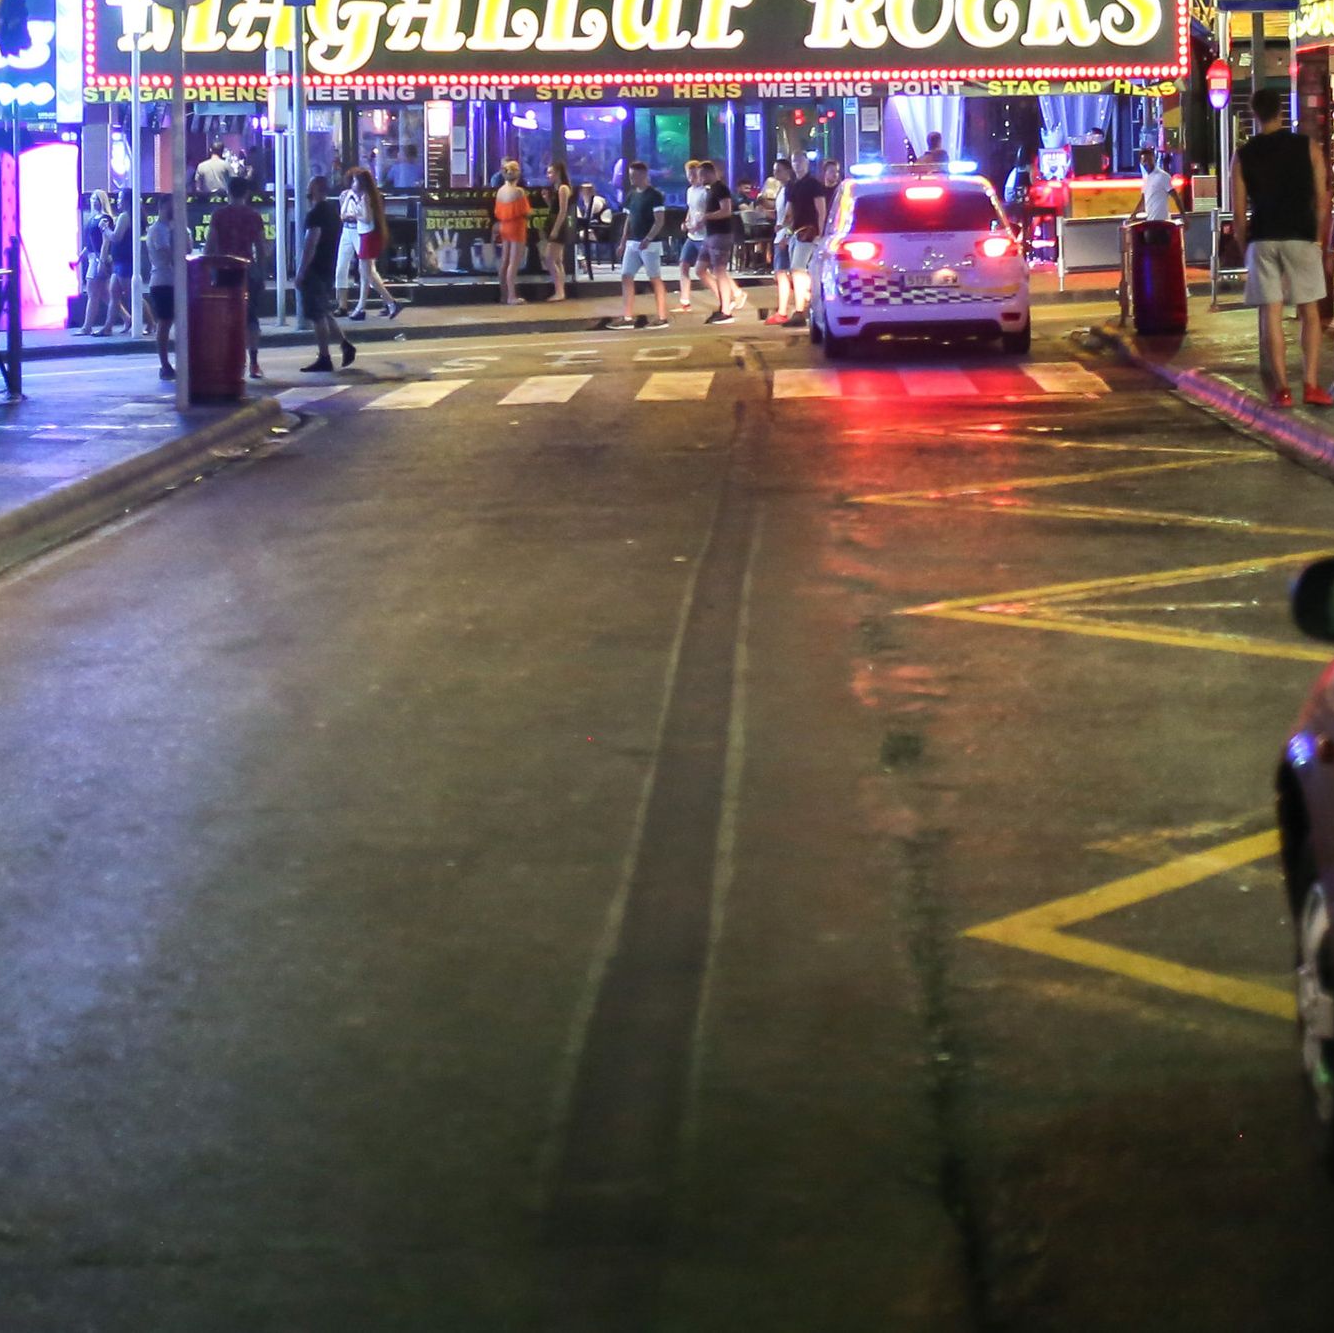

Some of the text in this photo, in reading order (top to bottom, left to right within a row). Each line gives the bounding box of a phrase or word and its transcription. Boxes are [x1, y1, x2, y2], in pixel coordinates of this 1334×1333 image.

[199, 86, 268, 102] HENS
[432, 85, 515, 100] POINT
[535, 84, 604, 100] STAG
[617, 85, 659, 98] AND
[673, 82, 742, 99] HENS
[757, 81, 873, 98] MEETING
[888, 80, 965, 96] POINT
[987, 80, 1051, 96] STAG
[1063, 81, 1102, 94] AND
[426, 216, 492, 230] BUCKET?
